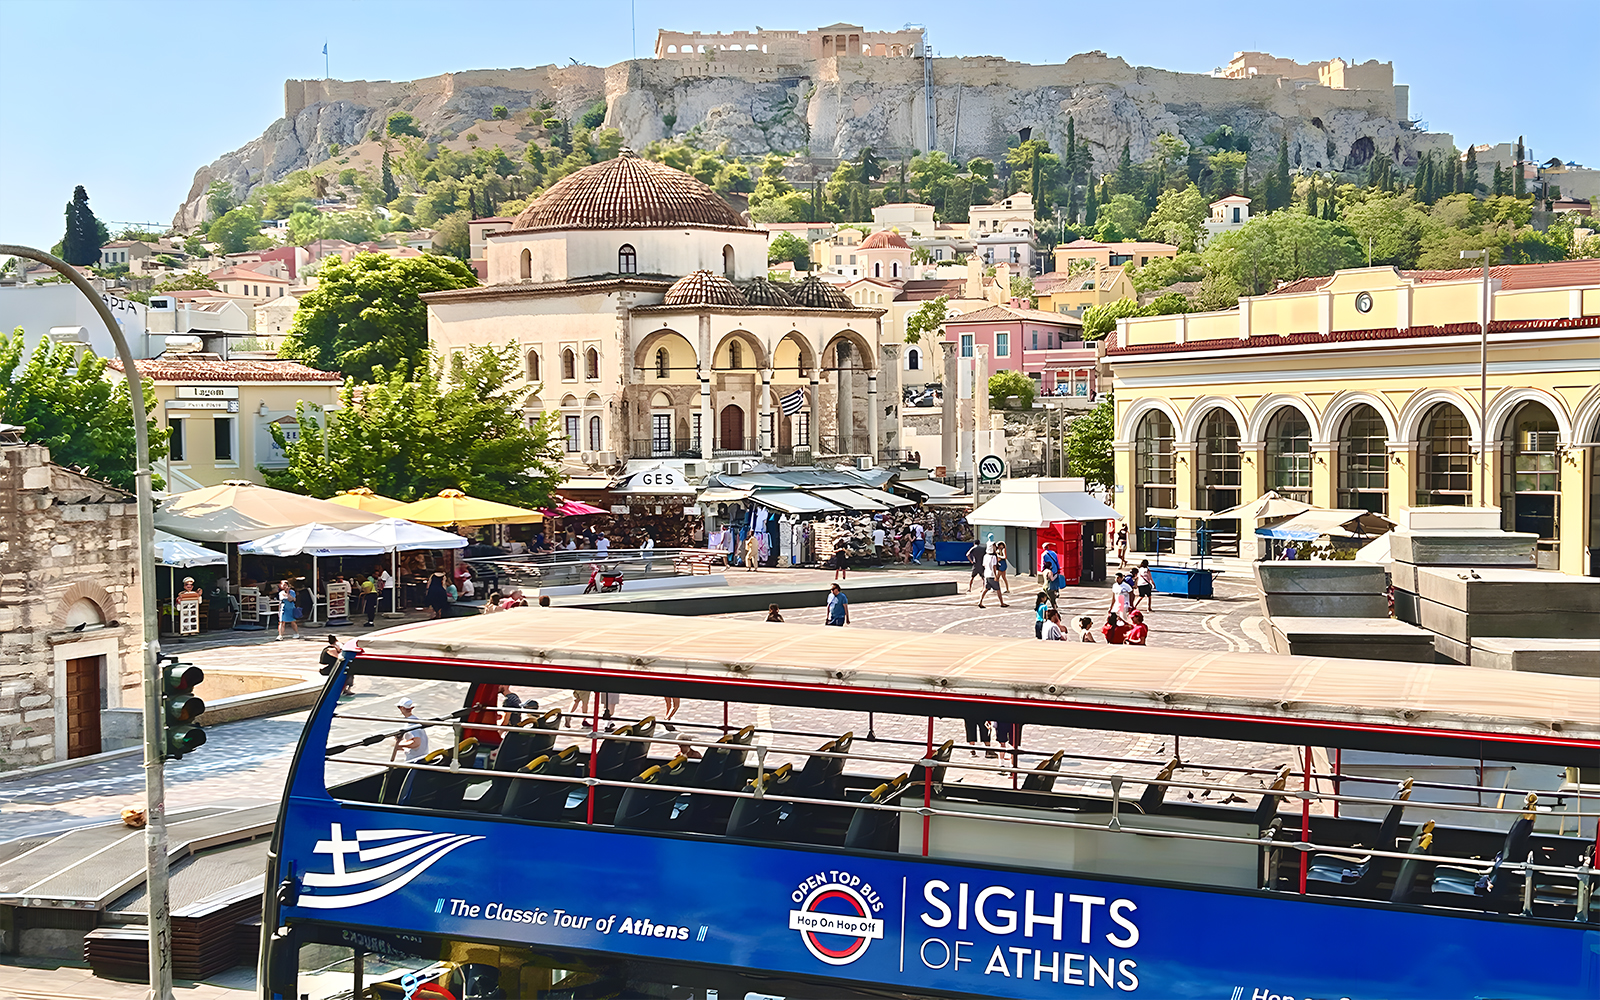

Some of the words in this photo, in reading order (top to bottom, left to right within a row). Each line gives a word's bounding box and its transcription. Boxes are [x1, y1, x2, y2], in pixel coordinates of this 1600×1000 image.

[643, 473, 674, 485] GES
[791, 871, 828, 903] OPEN
[829, 870, 861, 887] TOP
[859, 882, 884, 912] BUS
[450, 898, 479, 918] The
[484, 902, 548, 926] Classic
[552, 909, 592, 930] Tour
[595, 914, 617, 935] of
[618, 916, 690, 942] Athens
[797, 915, 818, 928] Hop
[820, 917, 834, 928] On
[836, 919, 858, 932] Hop
[859, 922, 876, 932] Off
[920, 879, 1140, 949] SIGHTS
[919, 937, 974, 972] OF
[984, 944, 1139, 992] ATHENS
